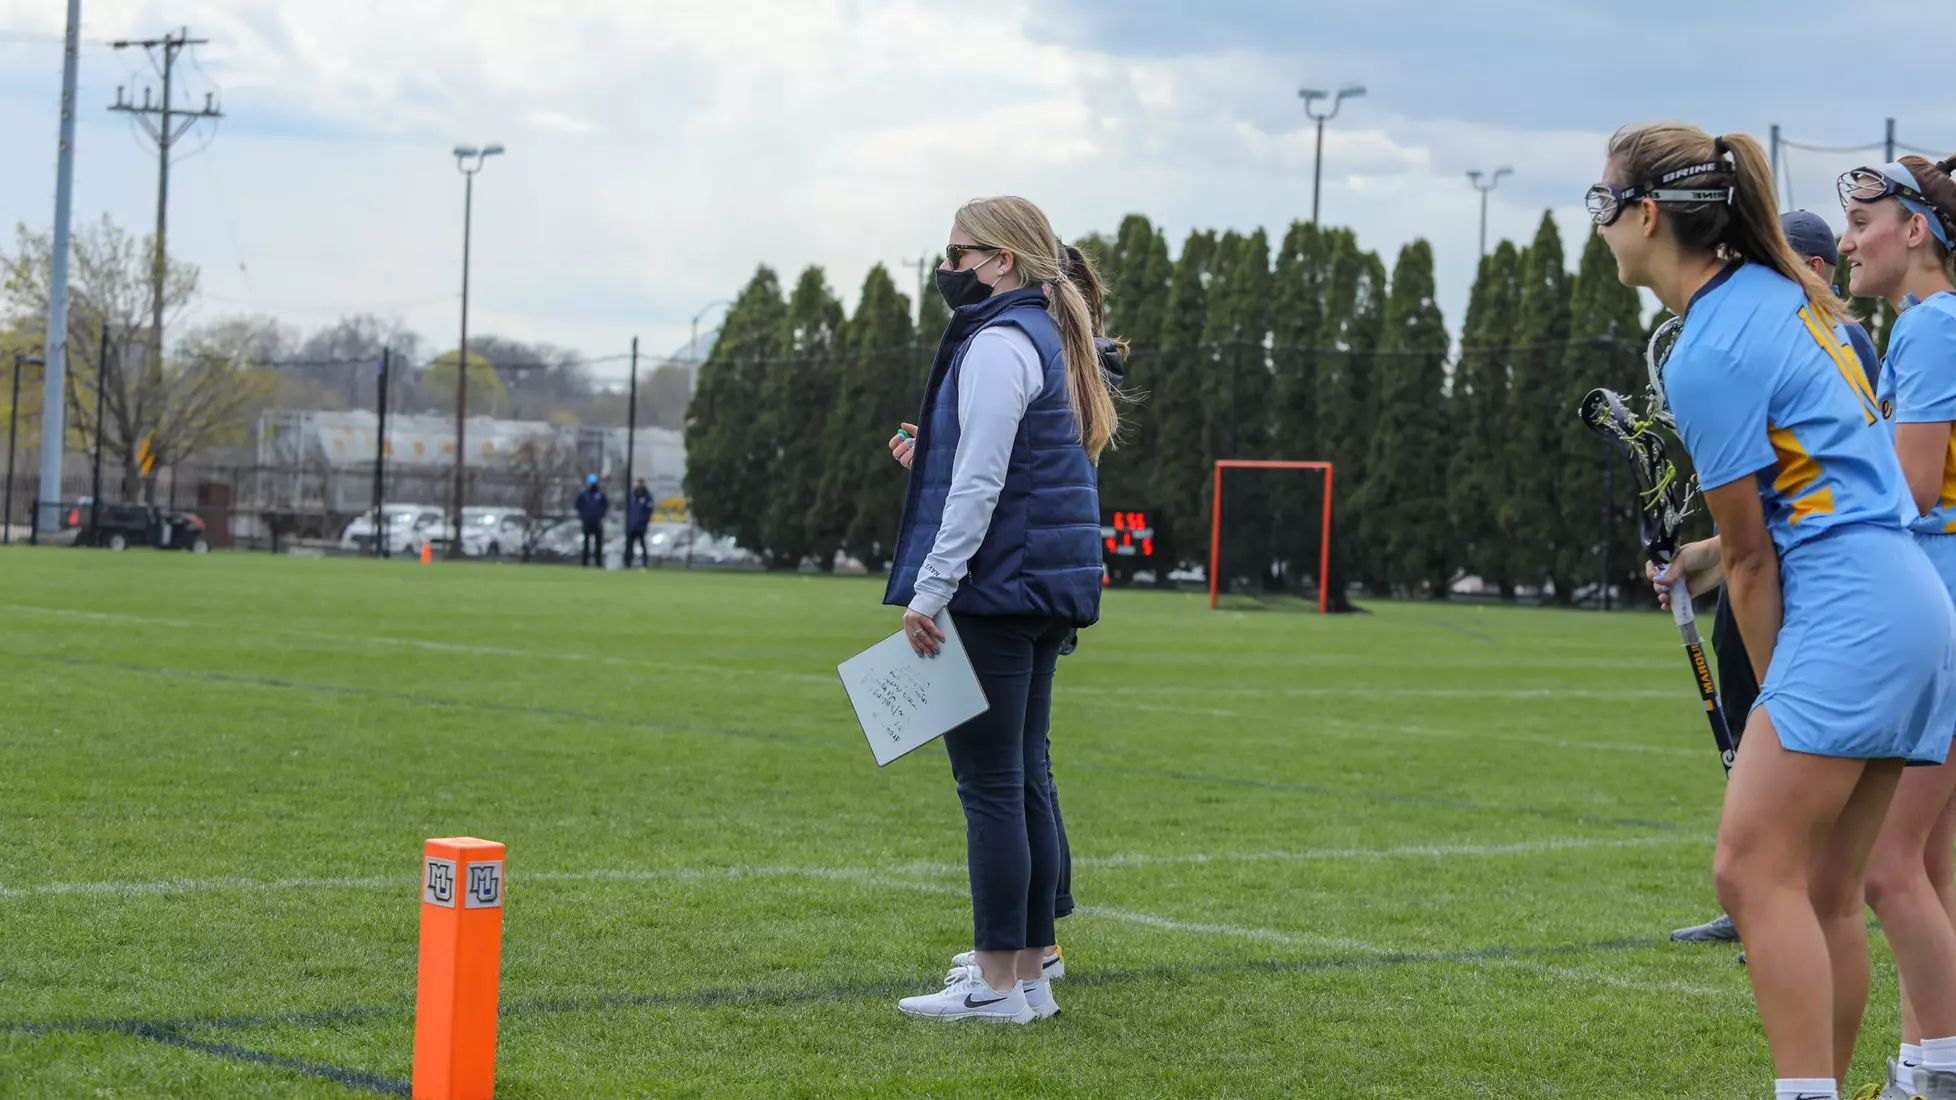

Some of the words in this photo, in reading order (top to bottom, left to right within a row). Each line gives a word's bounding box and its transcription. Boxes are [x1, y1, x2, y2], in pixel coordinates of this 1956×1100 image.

[1662, 162, 1716, 184] BRINE
[1691, 643, 1714, 694] MARQU
[428, 862, 453, 902] MU
[469, 865, 500, 903] MU
